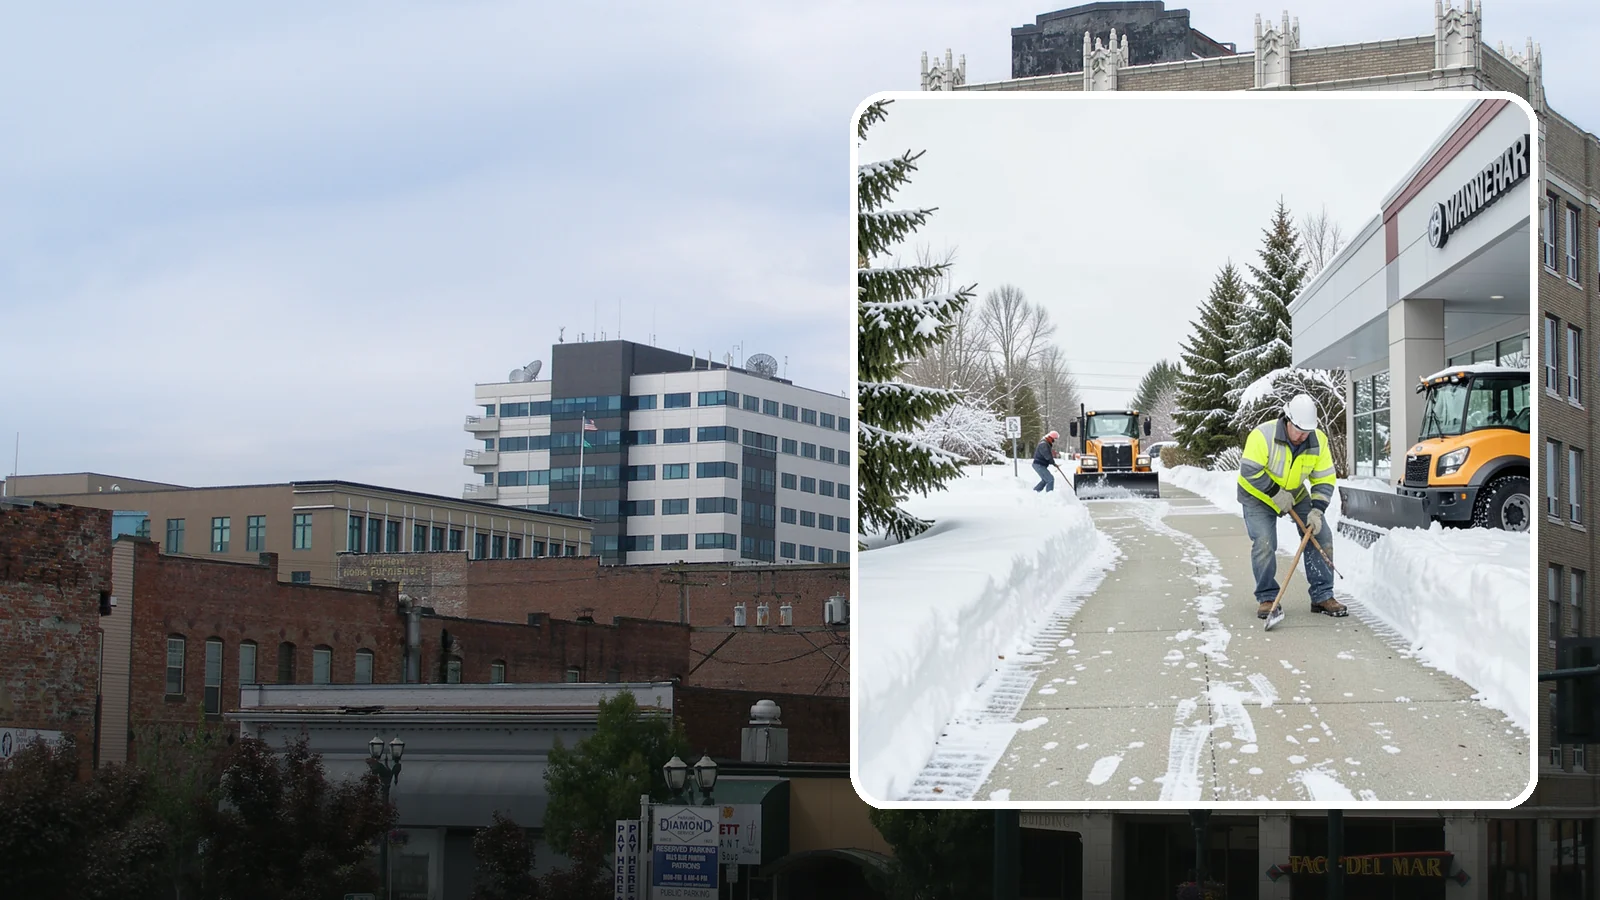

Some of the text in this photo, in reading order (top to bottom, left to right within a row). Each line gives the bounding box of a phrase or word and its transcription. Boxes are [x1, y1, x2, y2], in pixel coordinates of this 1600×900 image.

[343, 567, 427, 577] Home Furnishers
[660, 818, 713, 833] DIAMOND
[1022, 815, 1071, 827] BUILDING
[656, 845, 716, 855] RESERVED PARKING
[616, 825, 625, 894] PAY HERE
[627, 824, 637, 893] PAY HERE
[721, 851, 738, 862] Soup
[671, 862, 701, 870] PATRONS
[1289, 855, 1442, 877] TAC DEL MAR
[661, 888, 710, 898] PUBLIC PARKING
